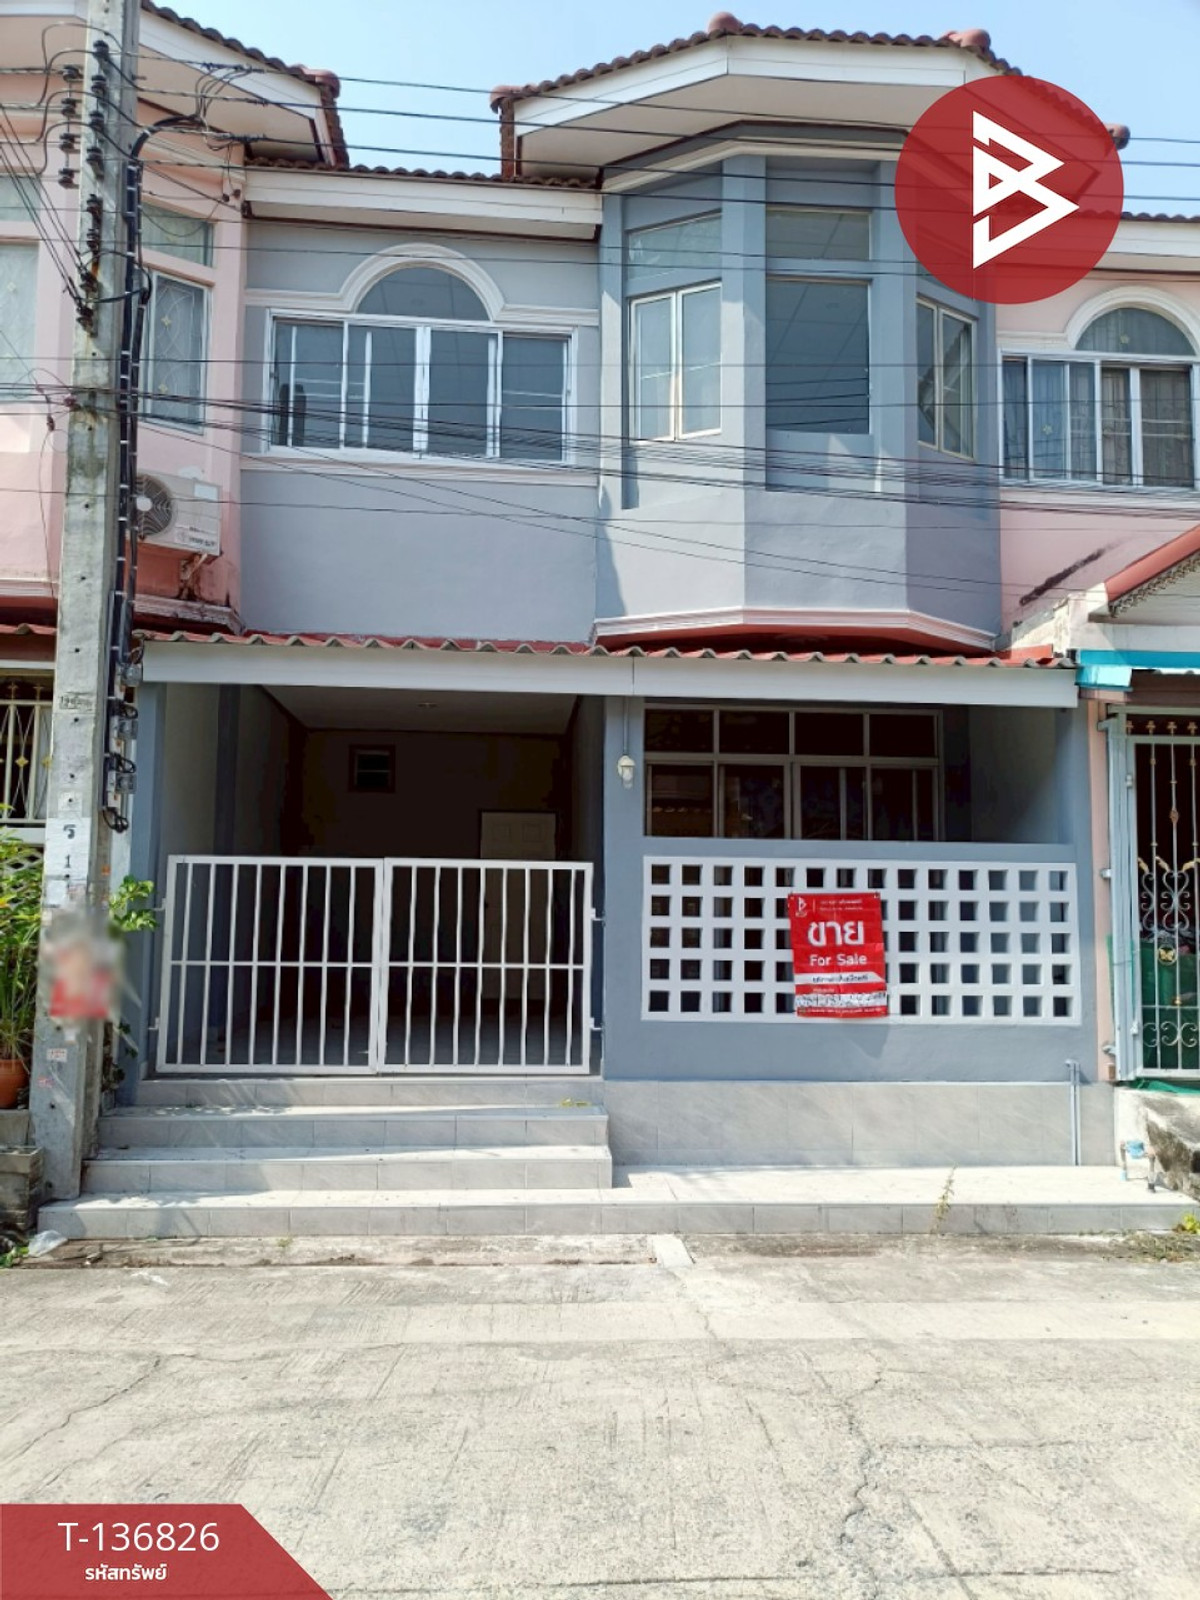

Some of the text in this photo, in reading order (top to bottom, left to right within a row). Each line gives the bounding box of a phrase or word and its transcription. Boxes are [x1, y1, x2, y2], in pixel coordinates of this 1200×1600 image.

[807, 920, 865, 947] ขาย
[809, 952, 868, 967] For Sale
